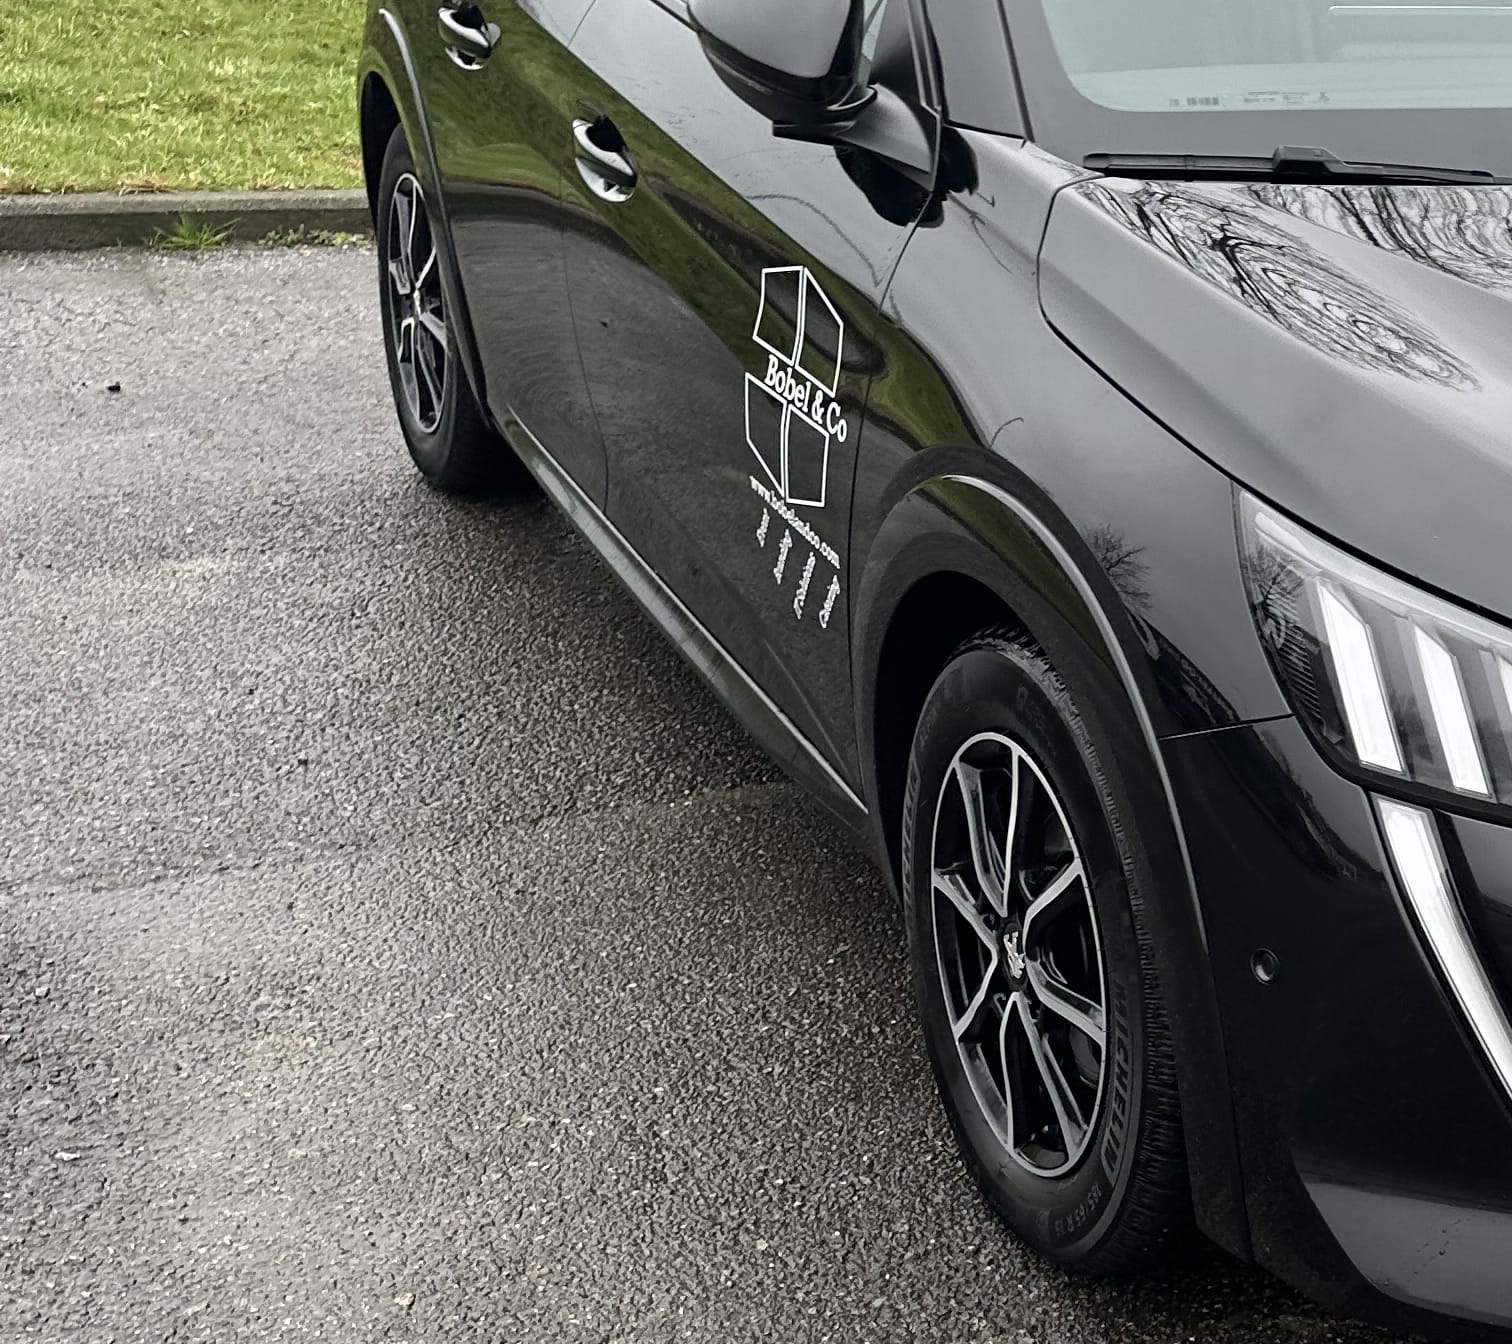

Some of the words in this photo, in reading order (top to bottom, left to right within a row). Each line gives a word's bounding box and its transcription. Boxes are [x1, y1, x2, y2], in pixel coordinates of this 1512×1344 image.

[764, 354, 812, 413] Bobel
[811, 389, 825, 425] &
[826, 401, 848, 443] Co
[1104, 978, 1129, 1175] MICHELIN
